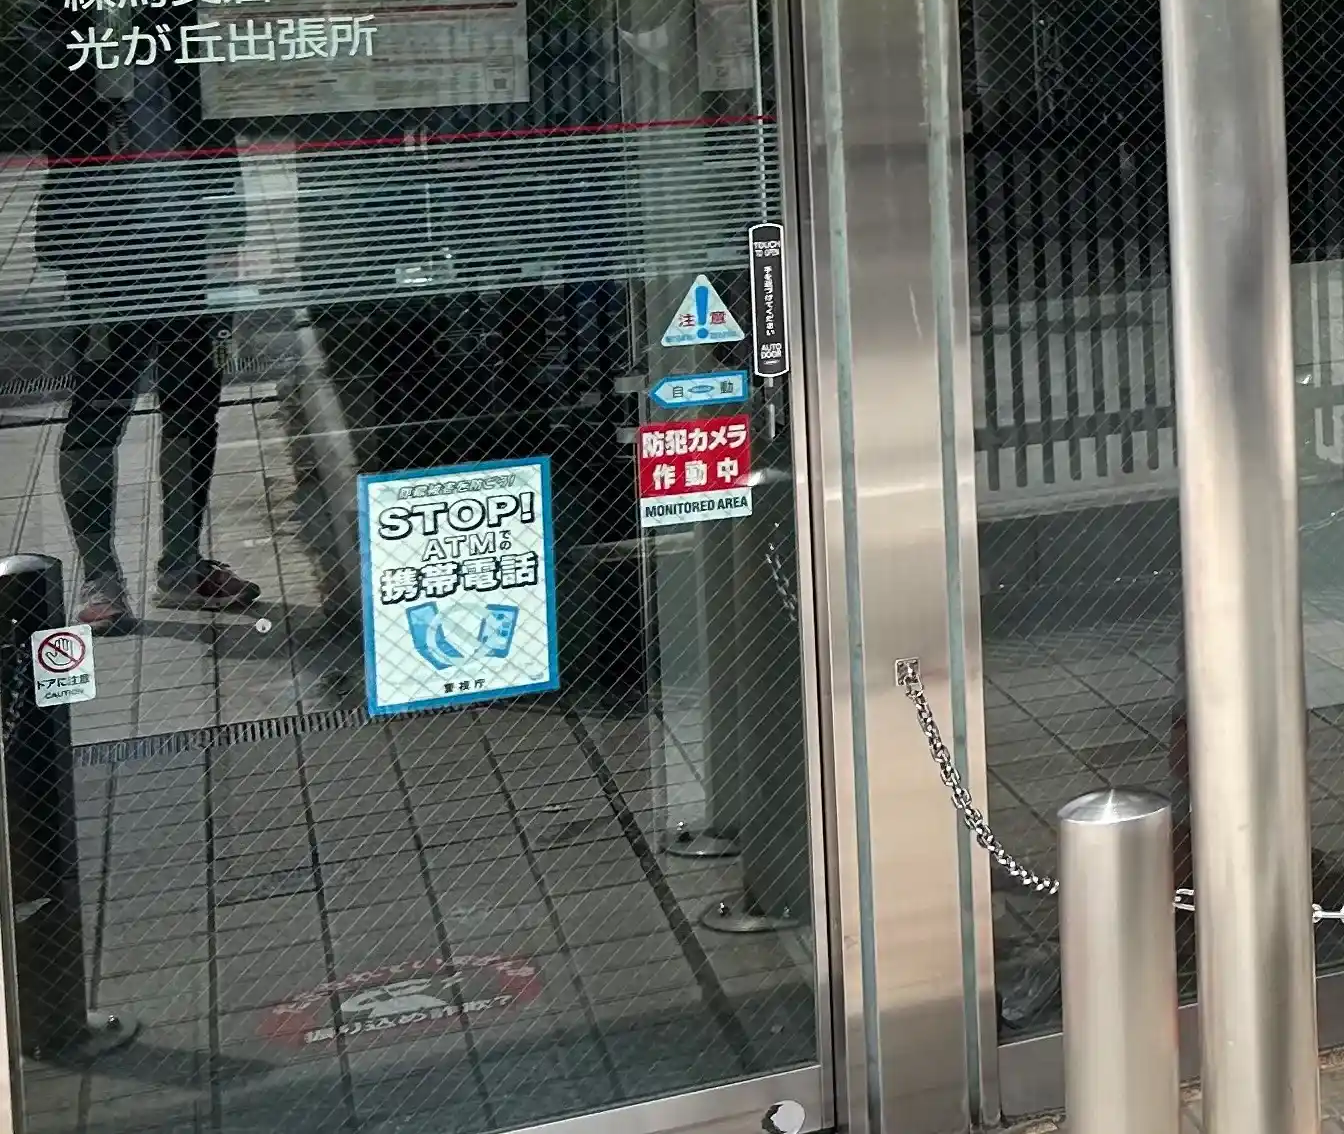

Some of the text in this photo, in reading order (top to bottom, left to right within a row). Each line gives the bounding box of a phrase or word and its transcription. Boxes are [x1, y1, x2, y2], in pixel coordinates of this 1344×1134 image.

[66, 14, 379, 72] 光が丘出張所
[761, 342, 782, 352] AUTO
[641, 423, 749, 460] 防犯カメラ
[652, 457, 740, 491] 作動中
[377, 491, 536, 541] STOP!
[645, 494, 749, 518] MONITORED AREA
[380, 550, 539, 606] 携帯電話
[443, 677, 486, 694] 警視庁
